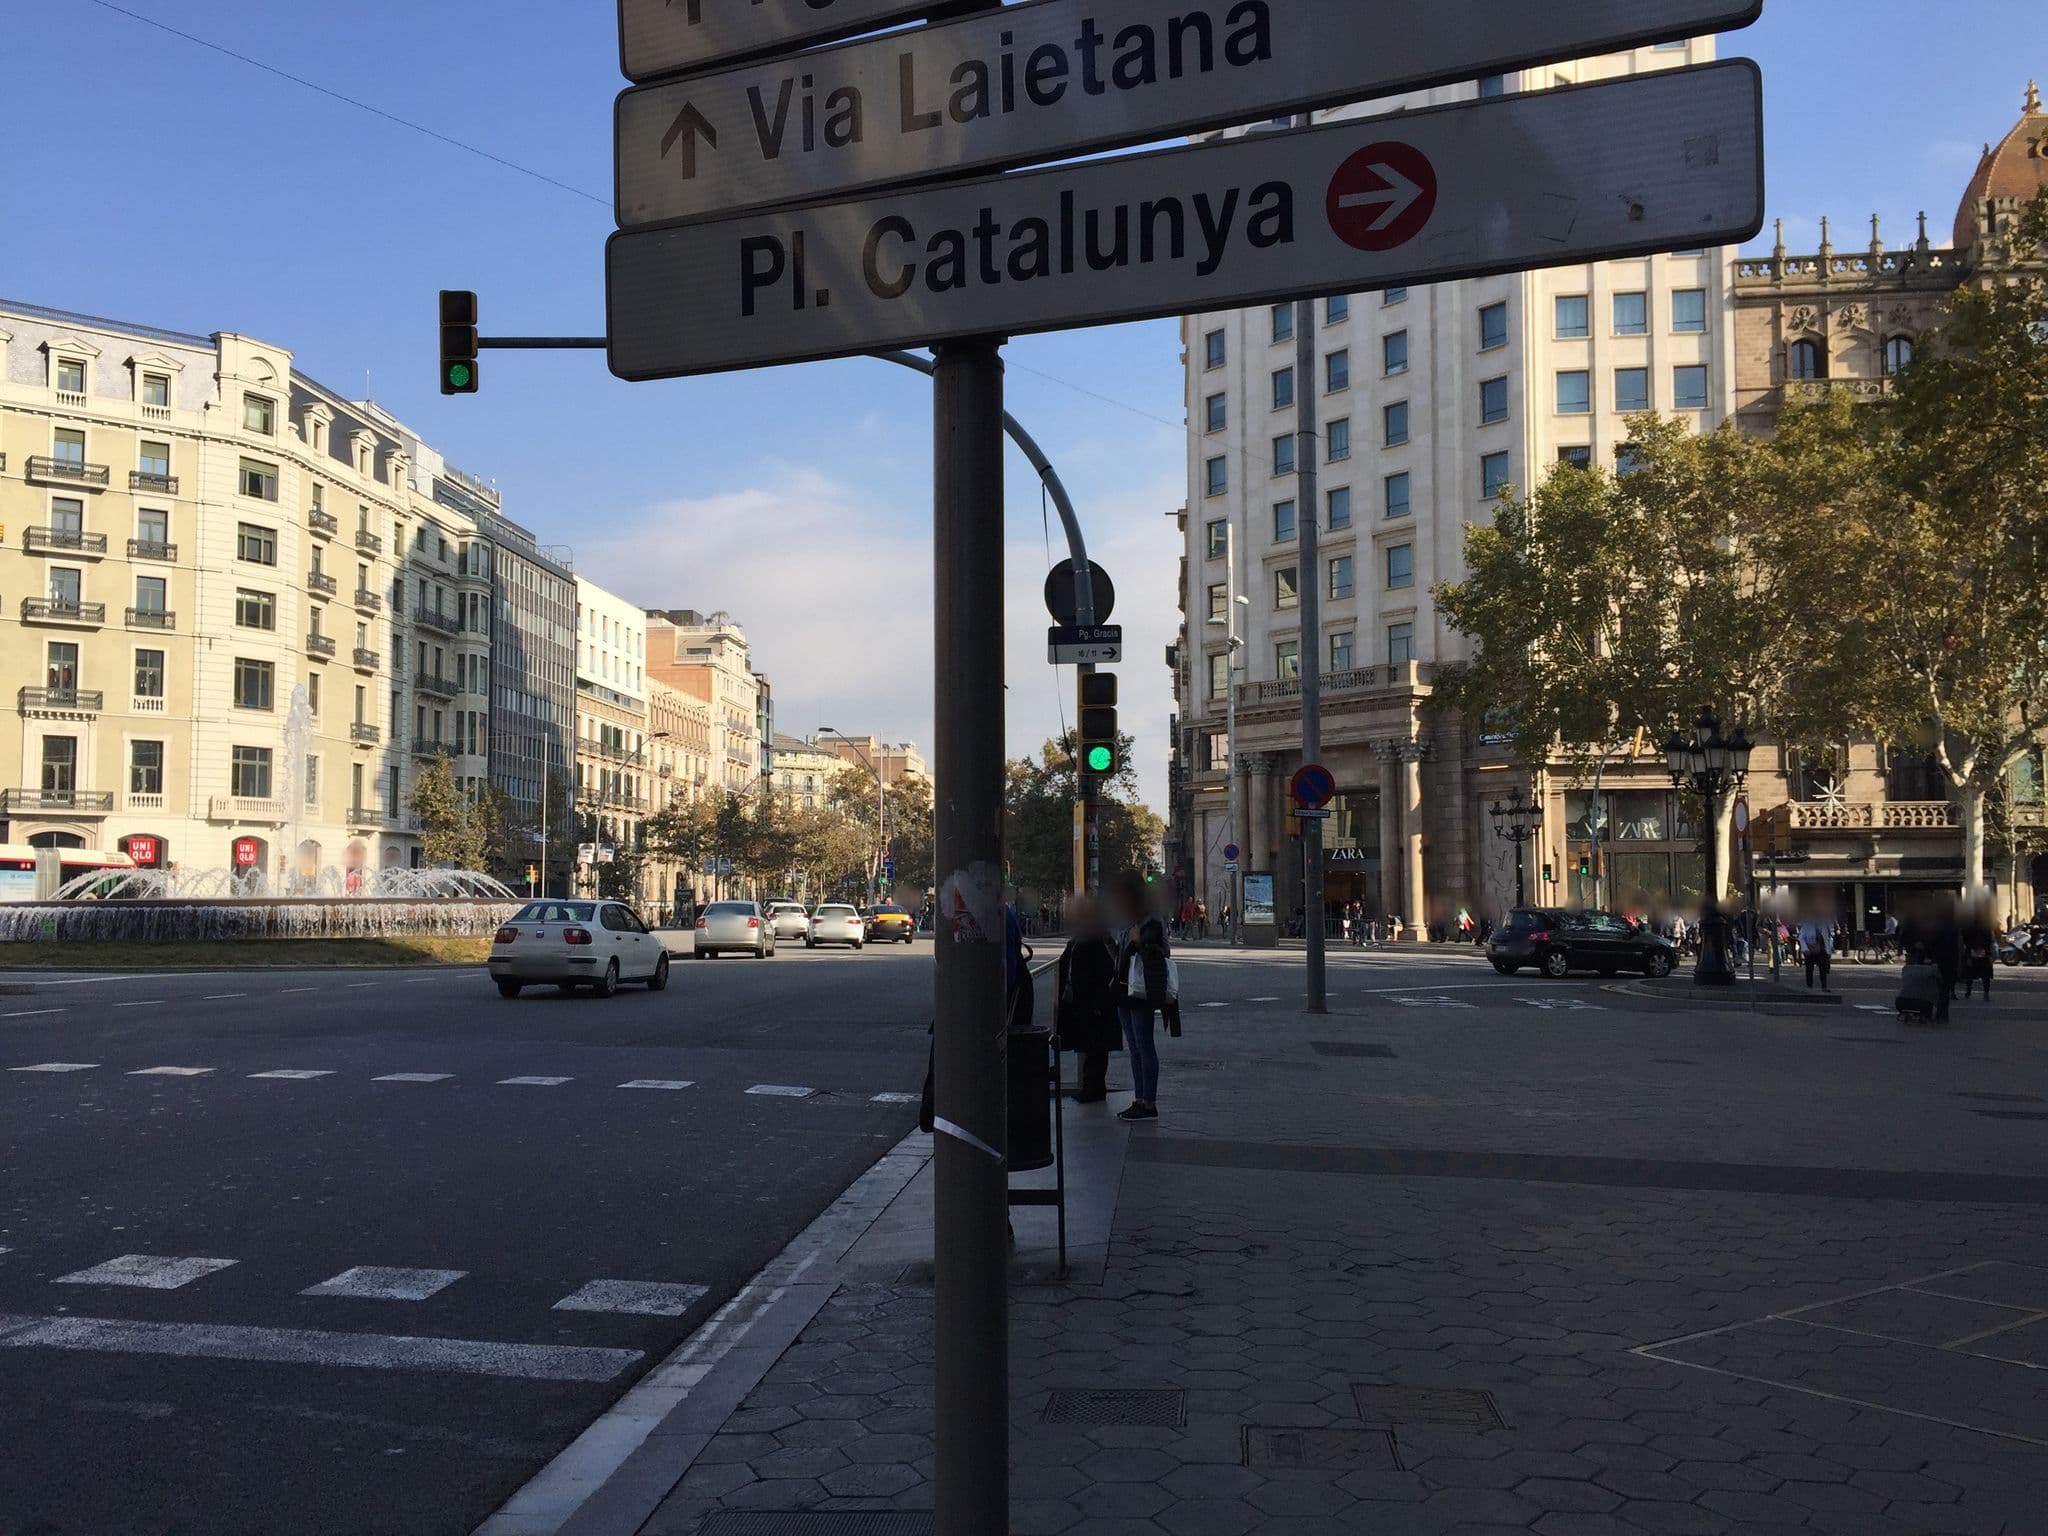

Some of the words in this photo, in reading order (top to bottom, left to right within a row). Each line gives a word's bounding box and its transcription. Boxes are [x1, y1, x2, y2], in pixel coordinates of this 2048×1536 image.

[746, 75, 863, 160] Via
[900, 0, 1272, 133] Laietana
[740, 230, 829, 316] Pl.
[862, 181, 1294, 299] Catalunya
[132, 842, 151, 850] UNI
[239, 843, 254, 852] UNI
[132, 851, 152, 860] QLO
[239, 852, 255, 862] QLO
[1331, 848, 1365, 860] ZARA
